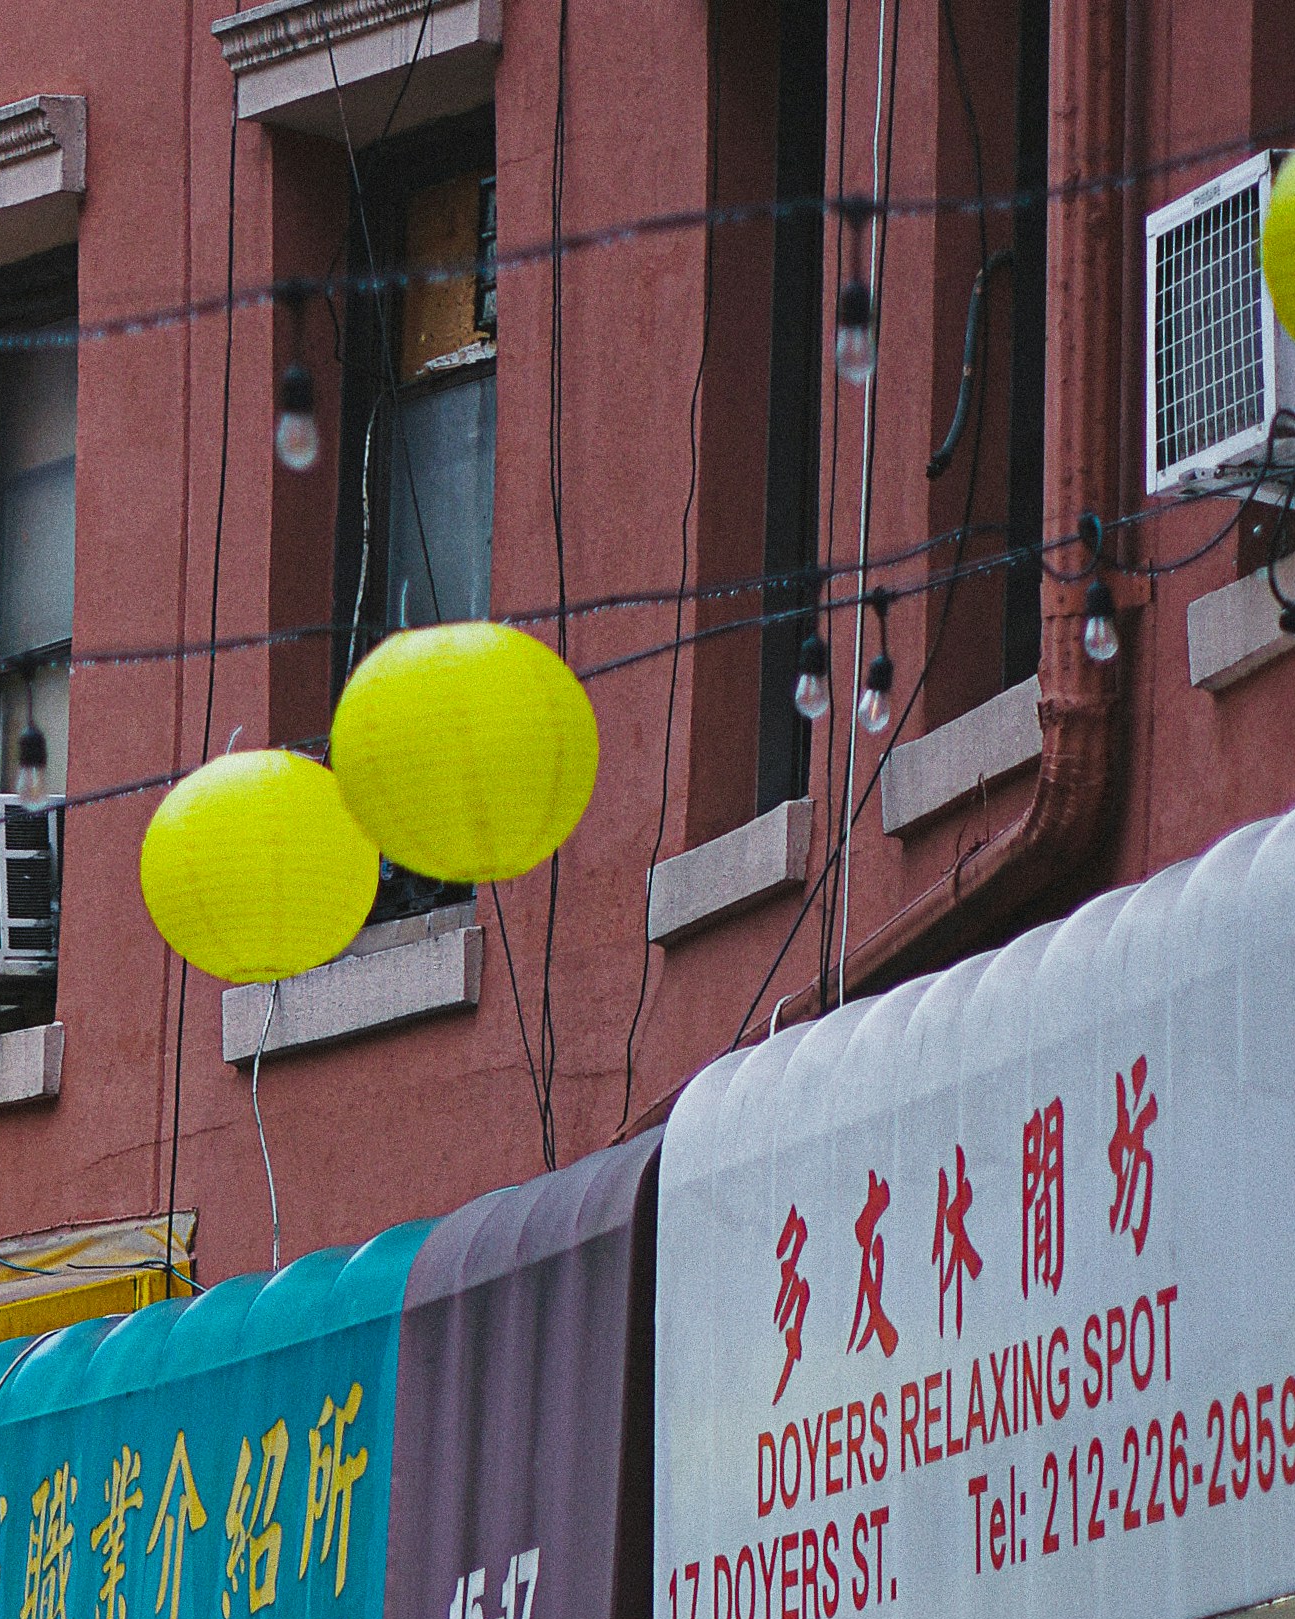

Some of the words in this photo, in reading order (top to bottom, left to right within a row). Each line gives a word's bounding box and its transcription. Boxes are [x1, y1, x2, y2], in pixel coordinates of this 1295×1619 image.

[758, 1392, 889, 1518] DOYERS
[900, 1328, 1070, 1474] RELAXING
[1082, 1285, 1178, 1407] SPOT
[851, 1506, 897, 1606] ST.
[968, 1474, 1027, 1576] Tel:
[1042, 1373, 1295, 1556] 212-226-2959
